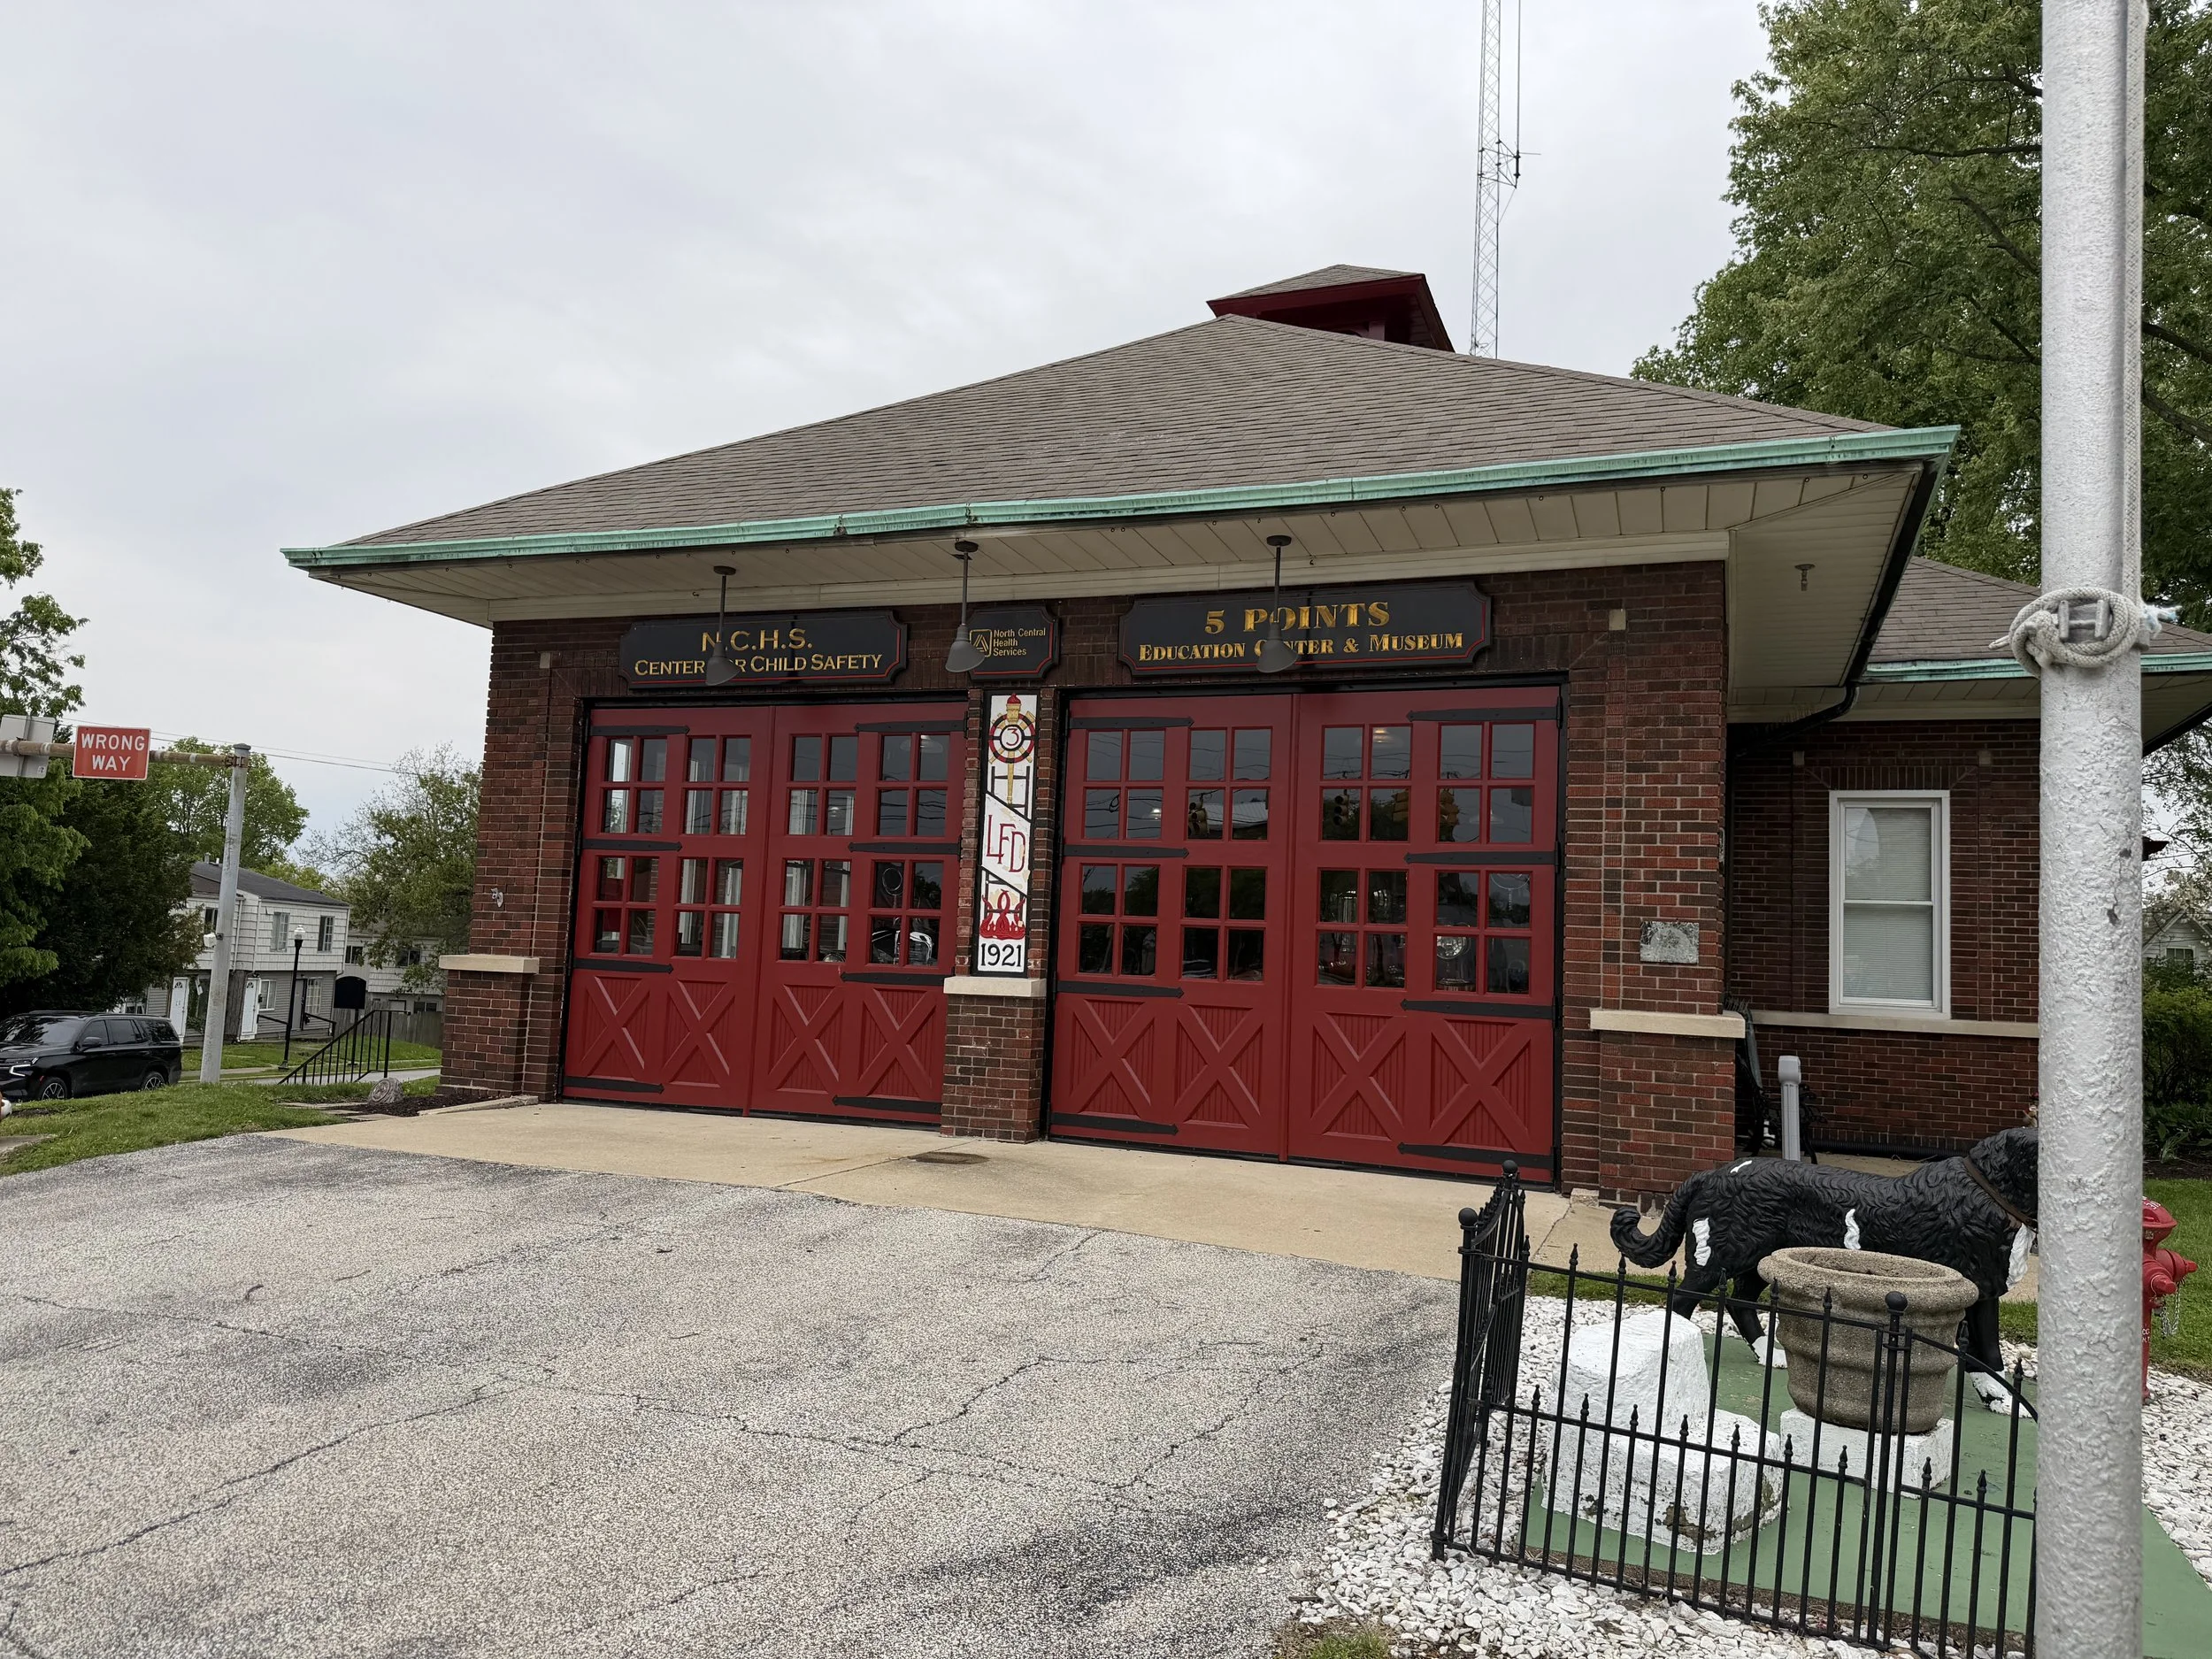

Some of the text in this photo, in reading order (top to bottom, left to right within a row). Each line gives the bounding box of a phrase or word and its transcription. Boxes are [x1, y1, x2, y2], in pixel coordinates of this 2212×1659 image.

[1204, 601, 1391, 634] 5 POINTS
[993, 627, 1046, 638] North Central
[993, 638, 1018, 648] Health
[993, 647, 1027, 657] Services
[1139, 632, 1463, 661] EDUCATION CNTER & MUSEUM
[634, 659, 706, 676] CENTER
[750, 655, 807, 672] CHILD
[810, 653, 883, 672] SAFETY
[81, 733, 145, 752] WRONG
[1006, 727, 1020, 747] 3
[92, 754, 132, 772] WAY
[986, 814, 1026, 873] LFD
[980, 942, 1022, 967] 1921
